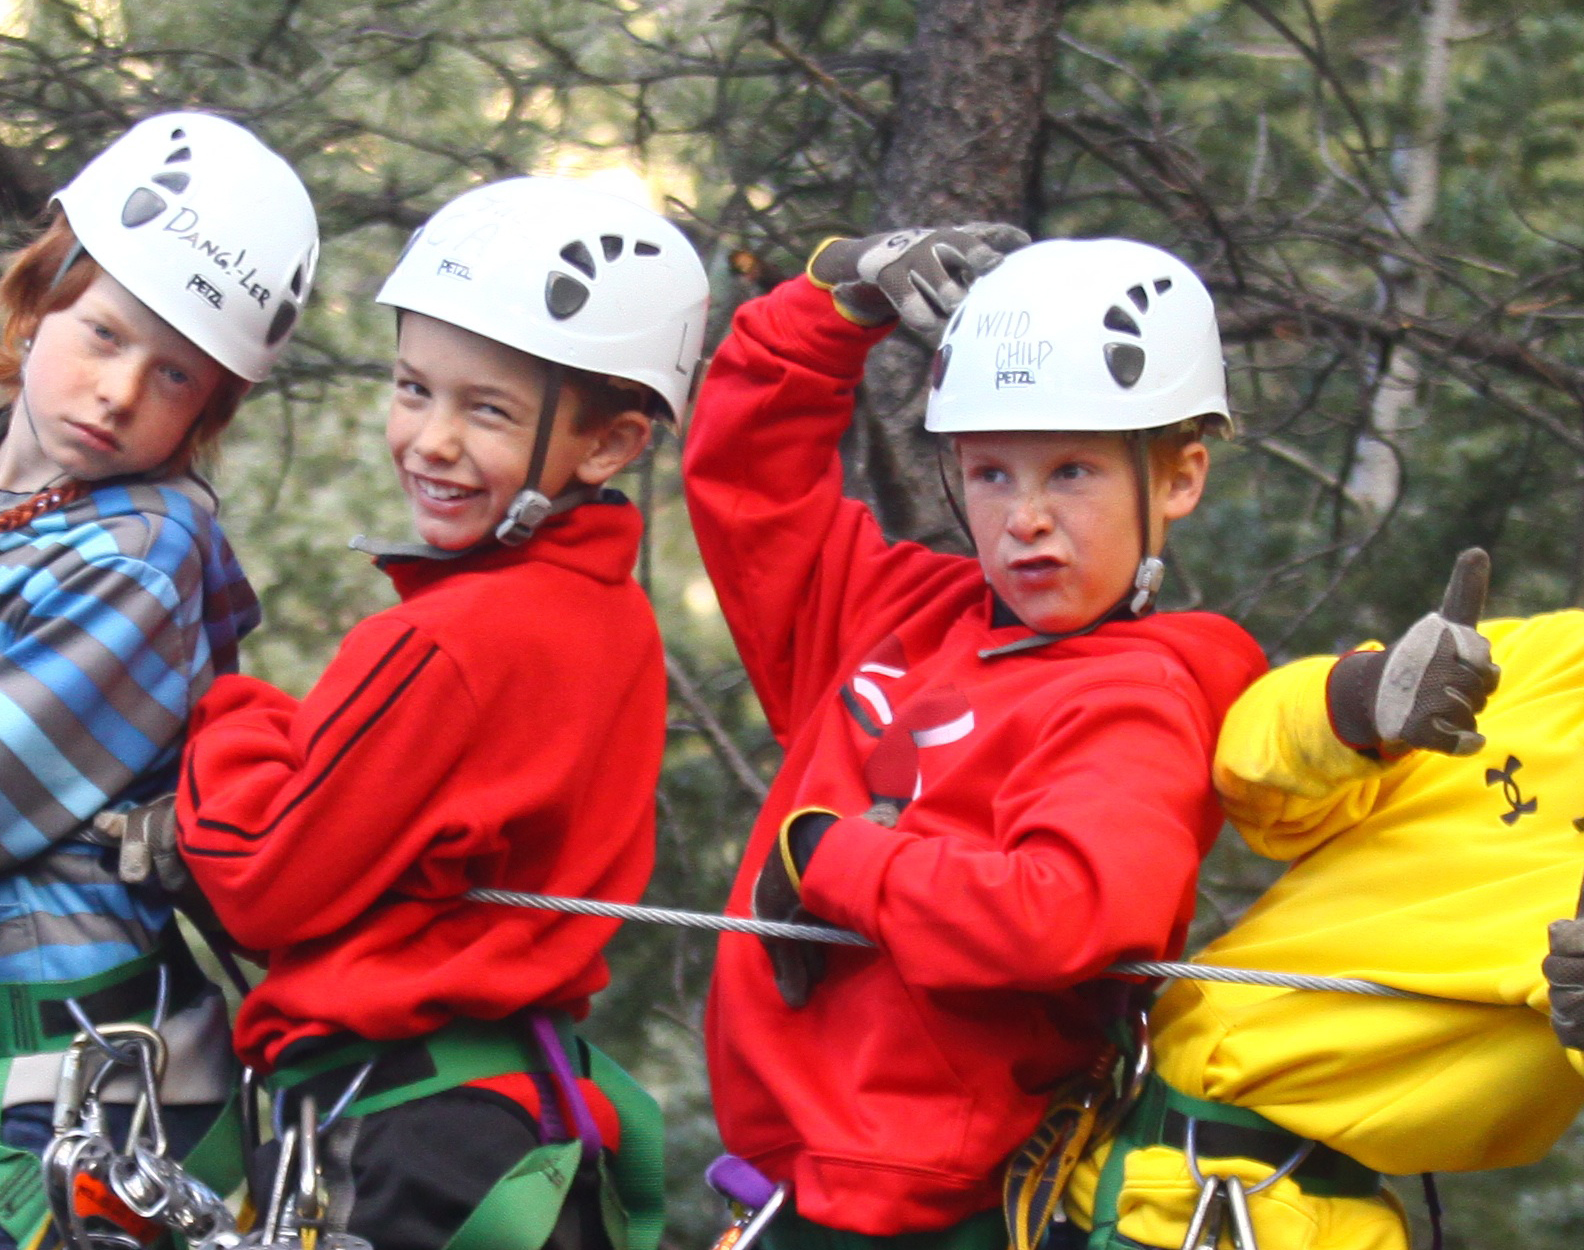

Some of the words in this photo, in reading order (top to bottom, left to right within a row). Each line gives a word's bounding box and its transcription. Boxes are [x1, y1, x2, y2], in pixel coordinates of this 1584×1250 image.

[437, 260, 473, 281] PETZL
[186, 274, 223, 310] PETZL
[976, 311, 1030, 339] WILD
[995, 340, 1053, 370] CHILD
[996, 371, 1036, 390] PETZL
